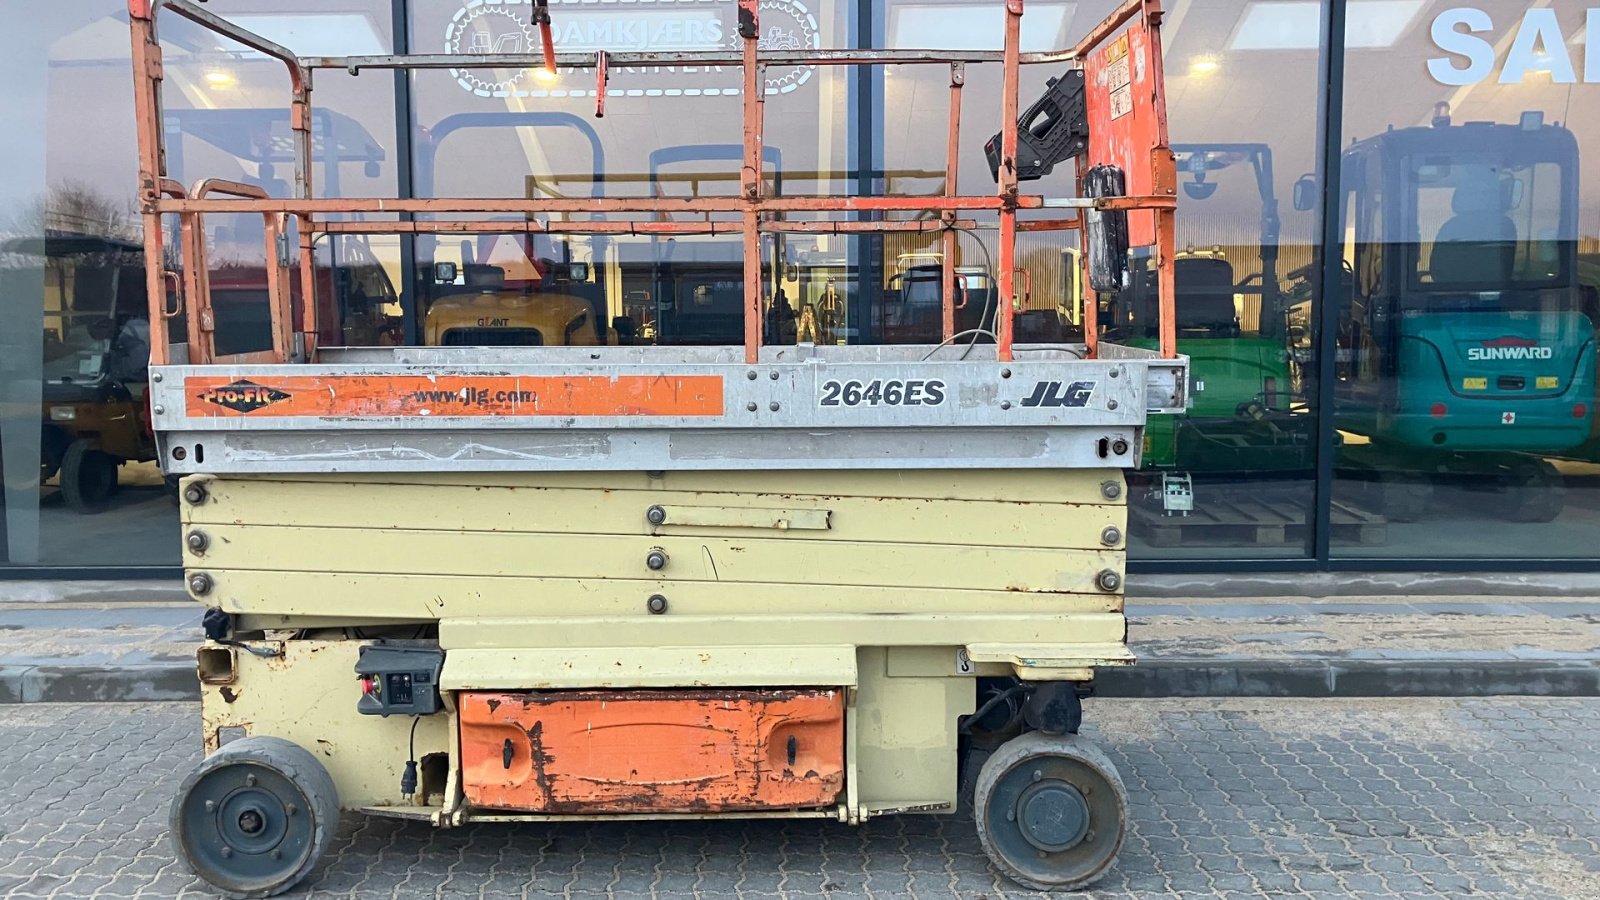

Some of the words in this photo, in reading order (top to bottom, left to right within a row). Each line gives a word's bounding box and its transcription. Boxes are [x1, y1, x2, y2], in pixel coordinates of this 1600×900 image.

[1427, 7, 1600, 86] SA
[1468, 347, 1552, 361] SUNWARD
[414, 387, 538, 407] www.jlg.com
[820, 380, 945, 406] 2646ES
[1019, 381, 1097, 407] JLG
